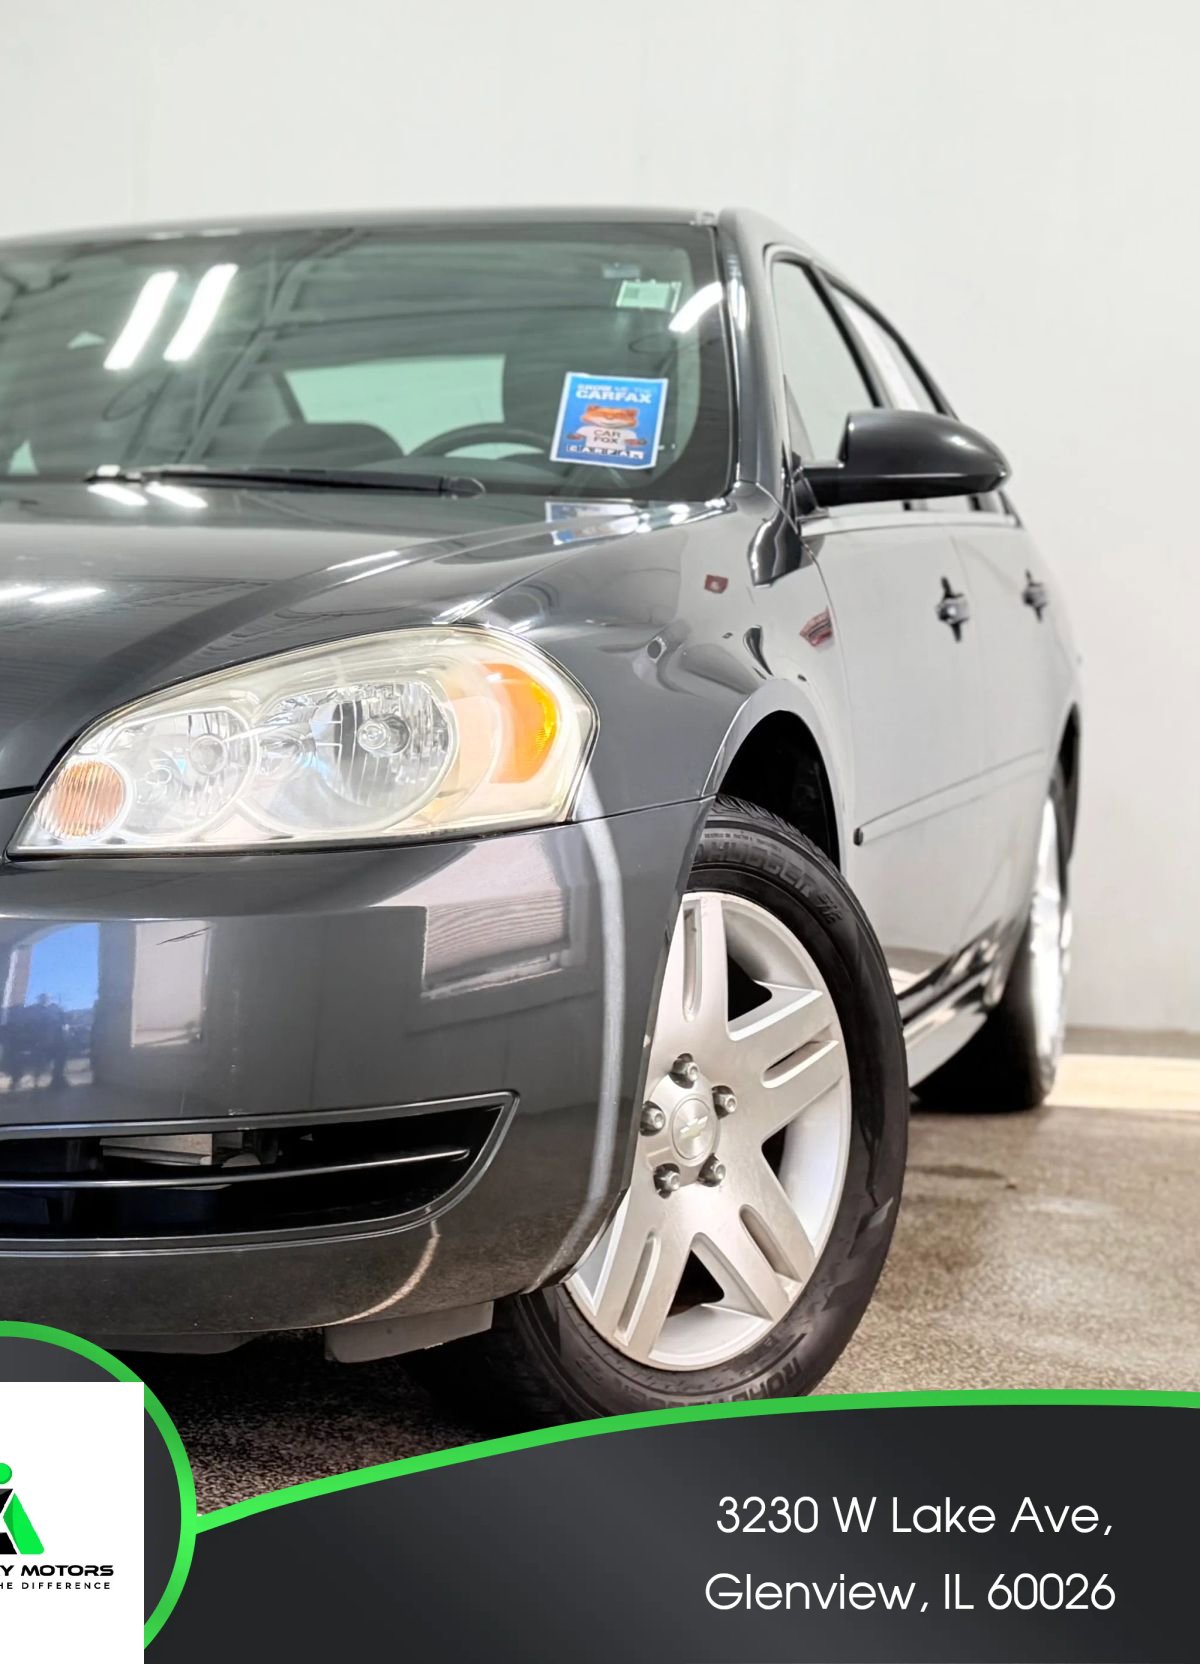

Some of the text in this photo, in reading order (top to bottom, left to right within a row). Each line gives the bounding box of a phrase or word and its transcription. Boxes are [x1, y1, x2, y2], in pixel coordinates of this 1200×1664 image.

[575, 389, 652, 404] CARFAX
[593, 429, 621, 438] CAR
[593, 436, 619, 444] FOX
